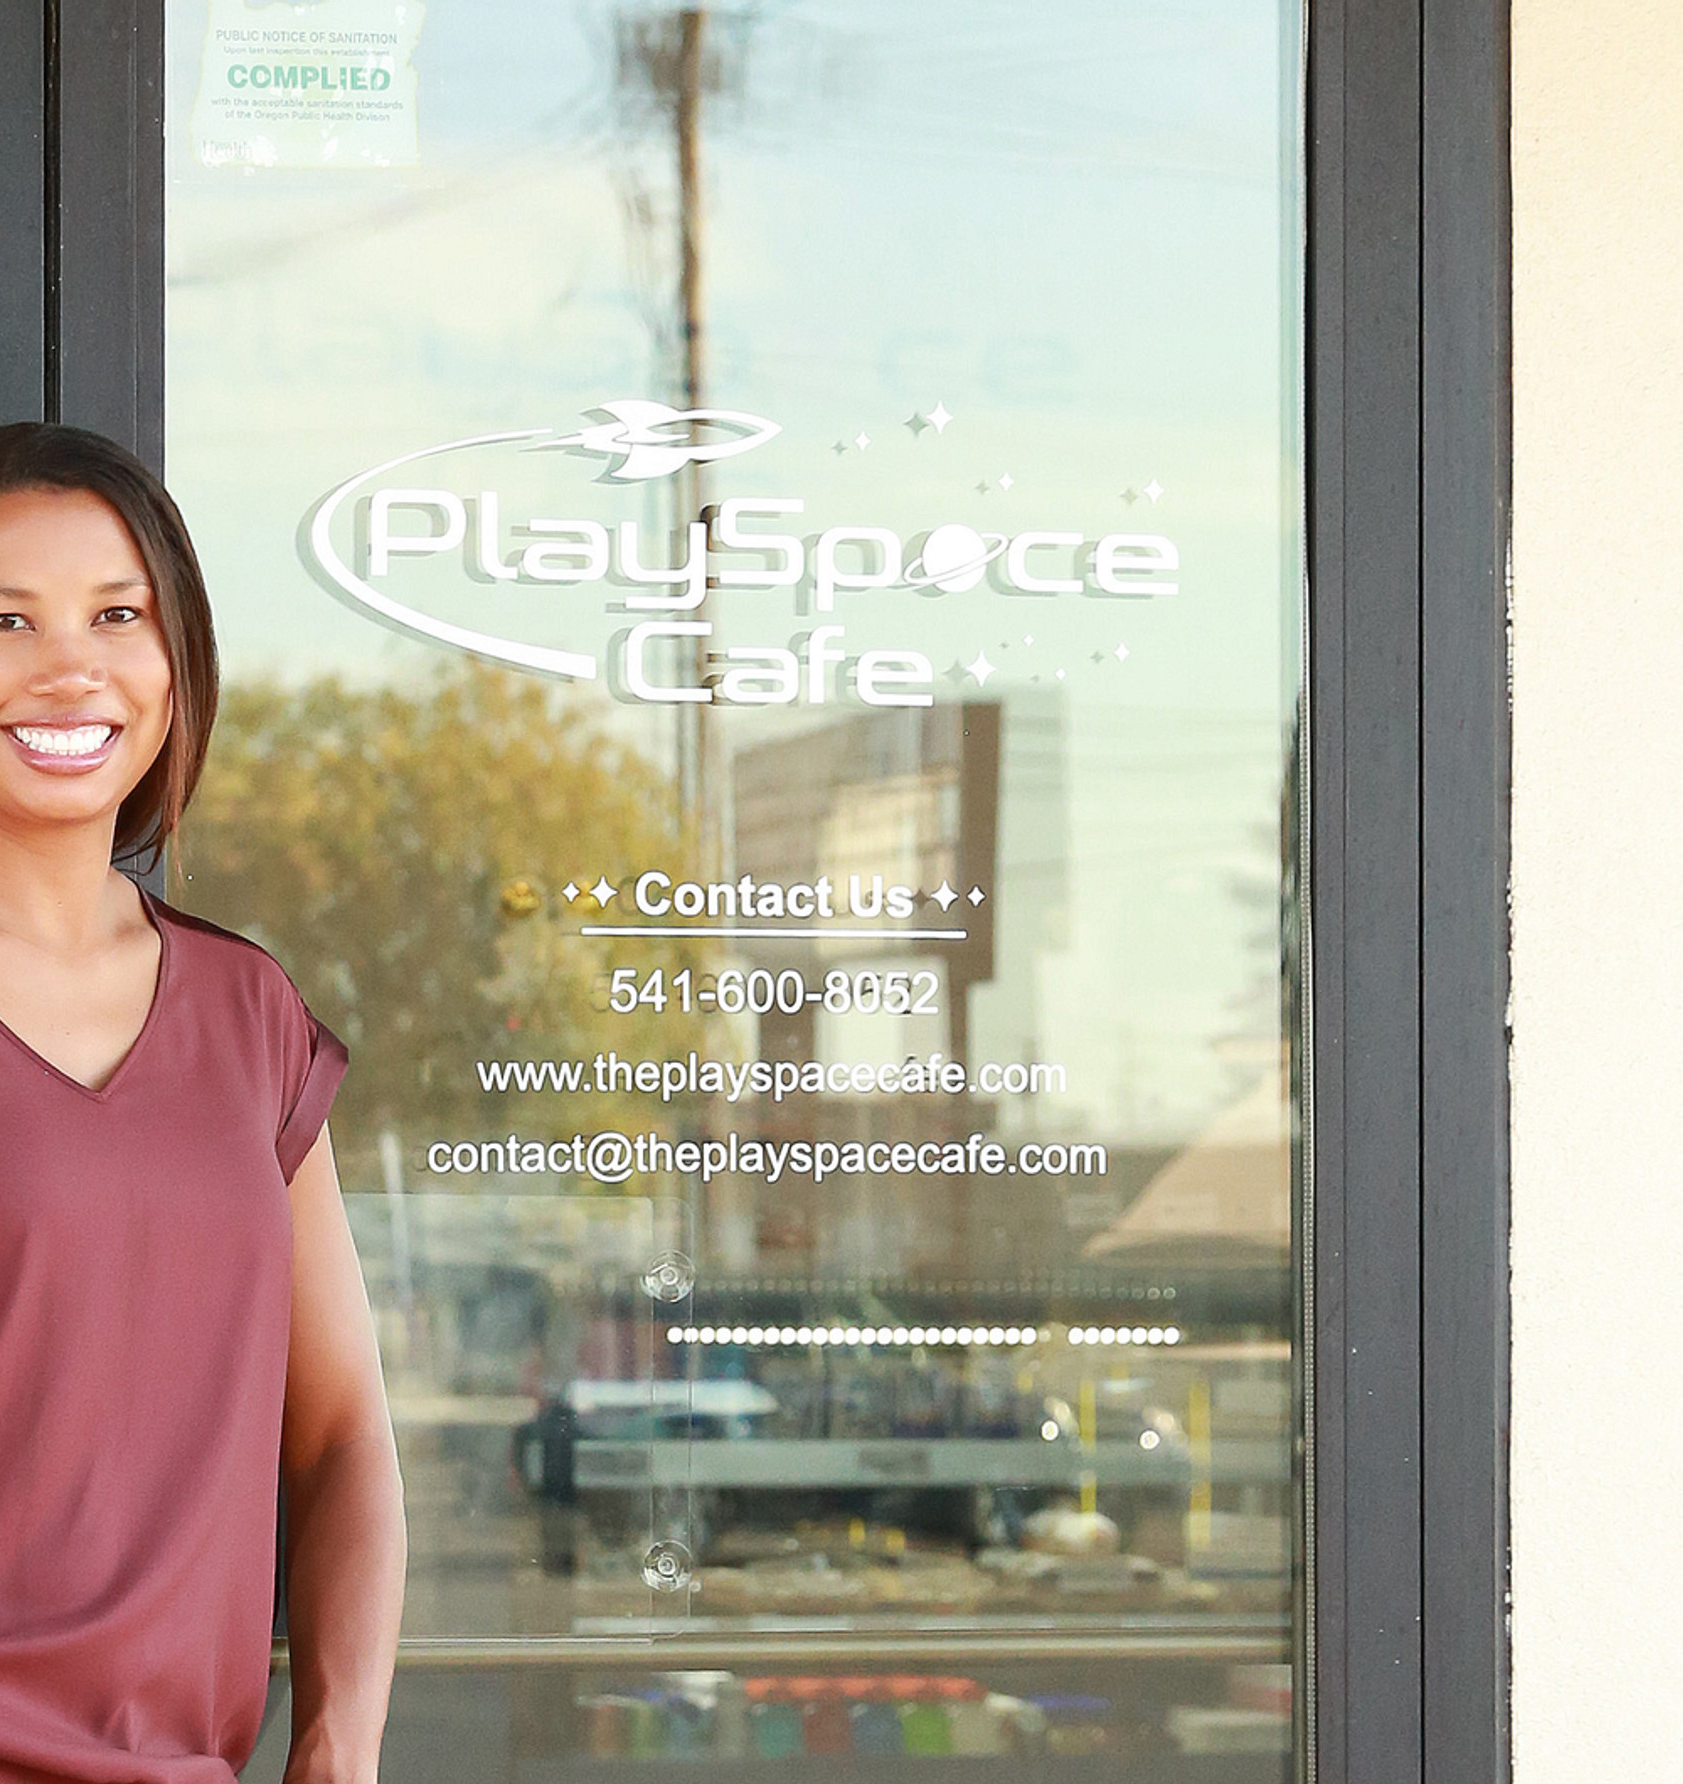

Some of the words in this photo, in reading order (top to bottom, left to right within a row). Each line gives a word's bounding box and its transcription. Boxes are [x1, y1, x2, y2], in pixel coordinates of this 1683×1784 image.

[215, 29, 259, 42] PUBLIC
[262, 30, 307, 43] NOTICE
[309, 31, 325, 44] OF
[328, 32, 398, 45] SANITATION
[223, 46, 247, 55] Upon
[330, 48, 390, 57] establishent
[226, 63, 392, 91] COMPLIED
[210, 97, 232, 107] with
[233, 97, 250, 107] the
[251, 98, 305, 109] acceptable
[306, 100, 354, 109] sanitation
[355, 100, 404, 110] standards
[224, 109, 235, 120] of
[236, 109, 252, 120] the
[253, 109, 290, 121] Oregon
[291, 110, 321, 120] Public
[322, 111, 354, 121] Health
[626, 621, 934, 706] Cafe
[635, 871, 834, 919] Contact
[849, 874, 914, 919] Us
[608, 968, 941, 1015] 541-600-8052
[476, 1051, 1068, 1102] www.theplayspacecafe.com
[427, 1131, 1107, 1182] contact@theplayspacecafe.com
